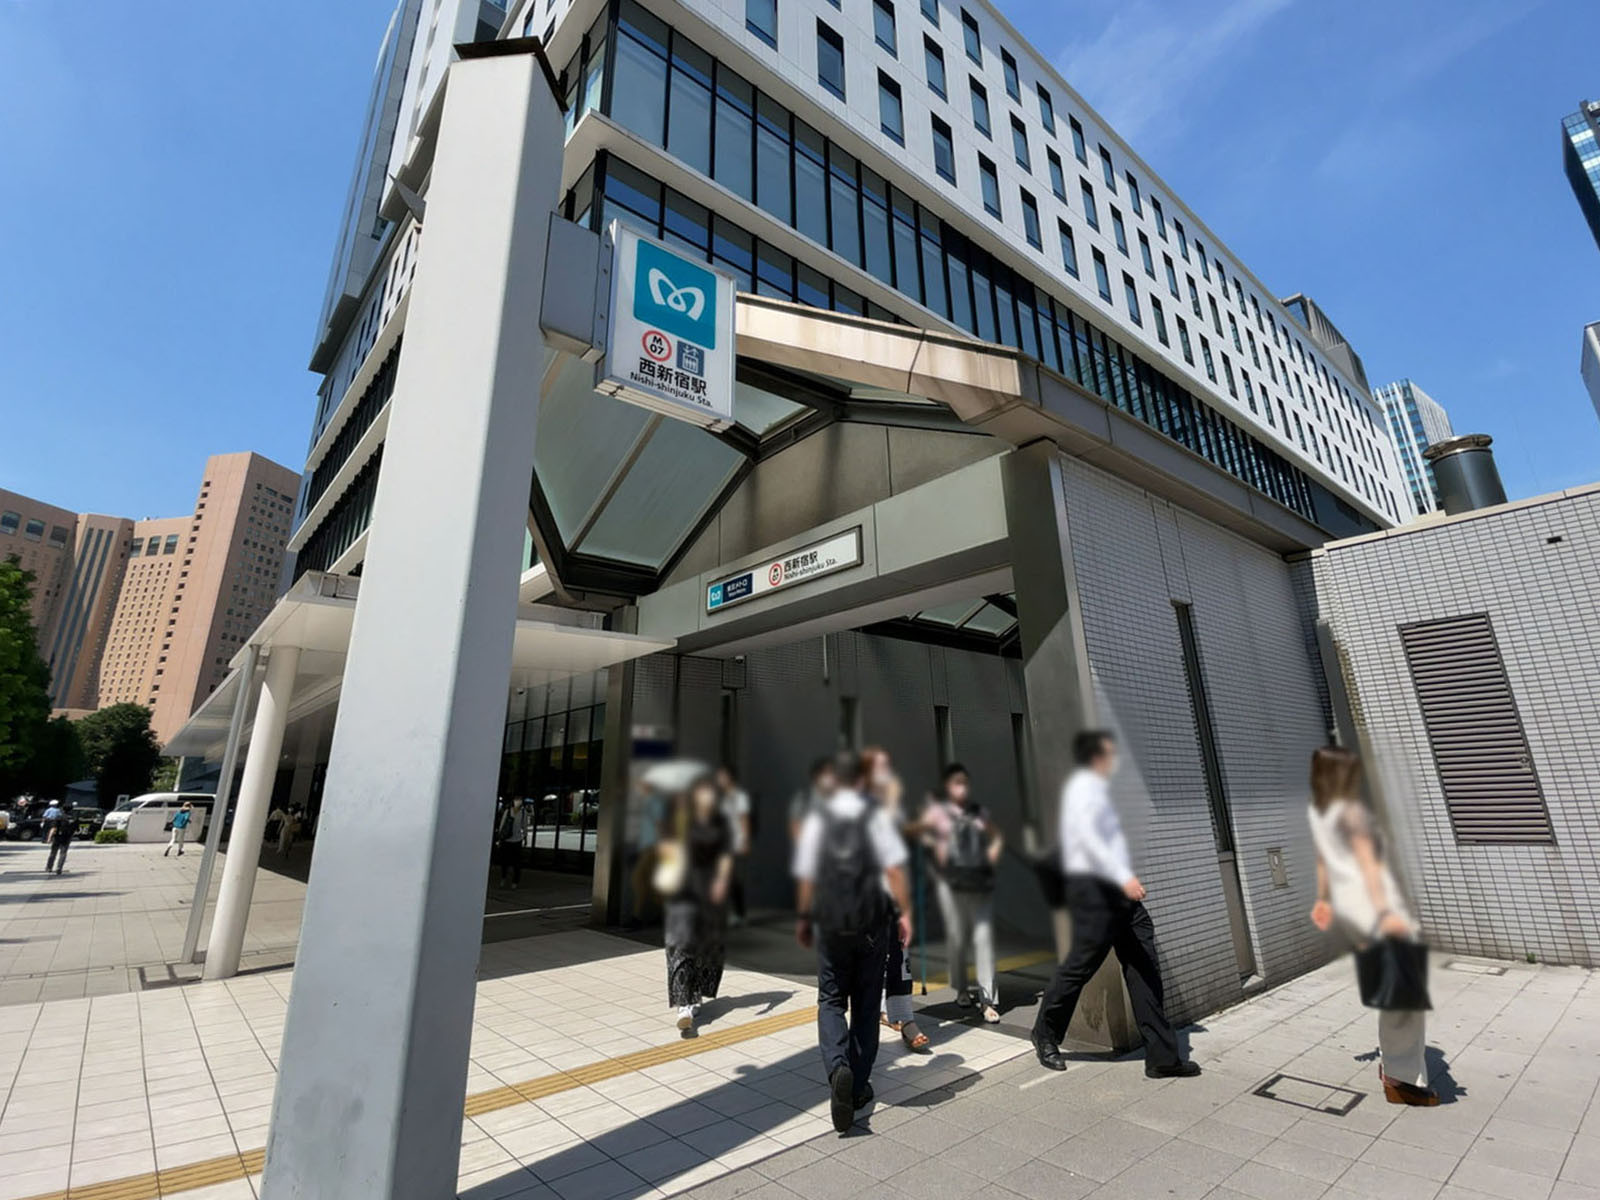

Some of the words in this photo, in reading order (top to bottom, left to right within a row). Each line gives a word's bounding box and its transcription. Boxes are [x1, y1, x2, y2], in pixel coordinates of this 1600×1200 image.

[652, 335, 663, 345] M
[649, 344, 664, 355] 07
[639, 357, 707, 395] 西新宿駅
[697, 395, 713, 408] Sta.
[784, 550, 818, 572] 西新宿駅
